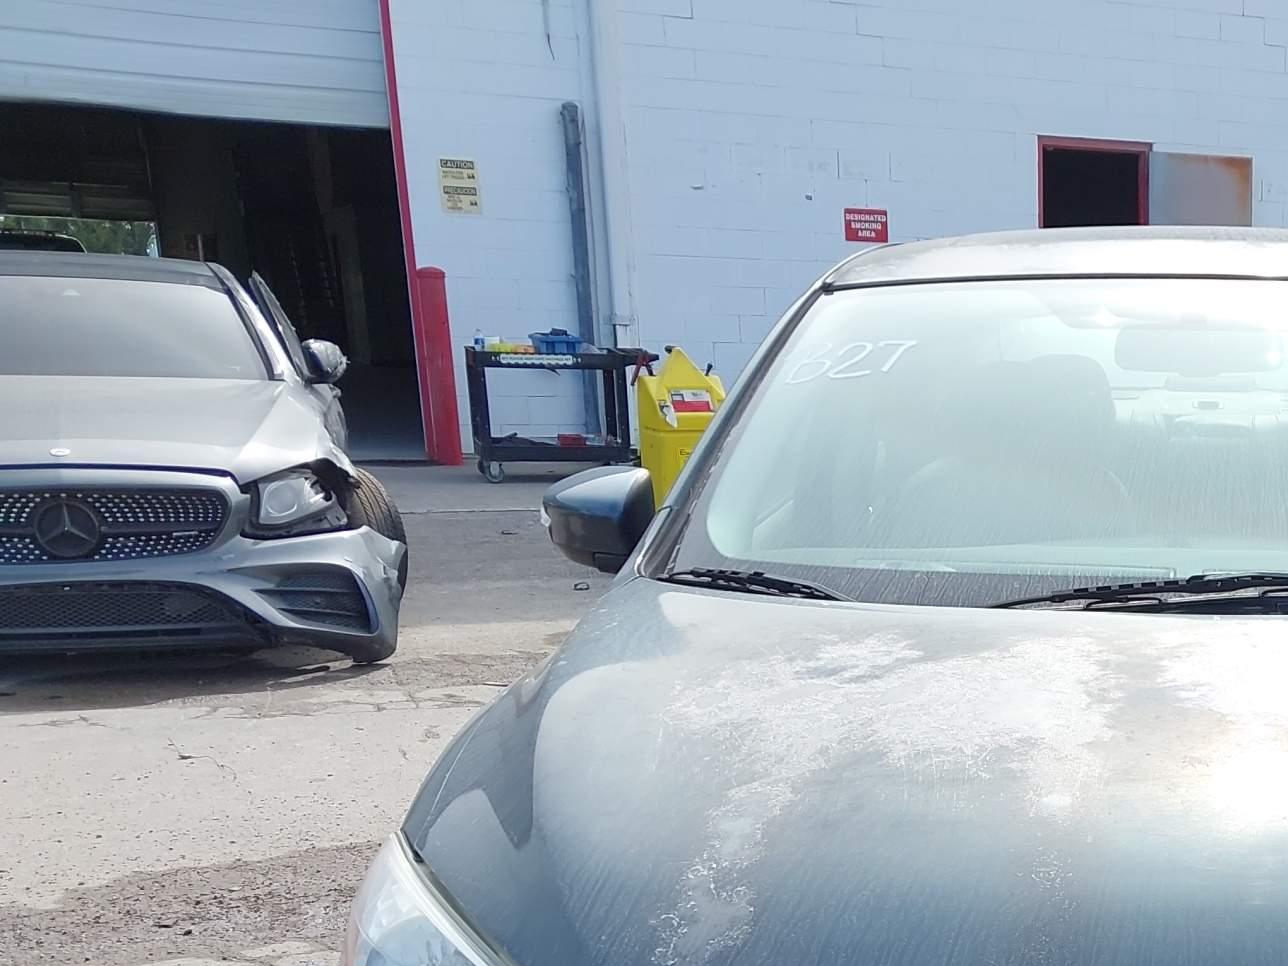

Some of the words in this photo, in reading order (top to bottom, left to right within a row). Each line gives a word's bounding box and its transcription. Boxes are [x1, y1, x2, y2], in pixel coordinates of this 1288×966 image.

[441, 160, 474, 169] CAUTION
[845, 212, 887, 222] DESIGNATED
[850, 221, 882, 230] SMOKING
[857, 229, 876, 238] AREA
